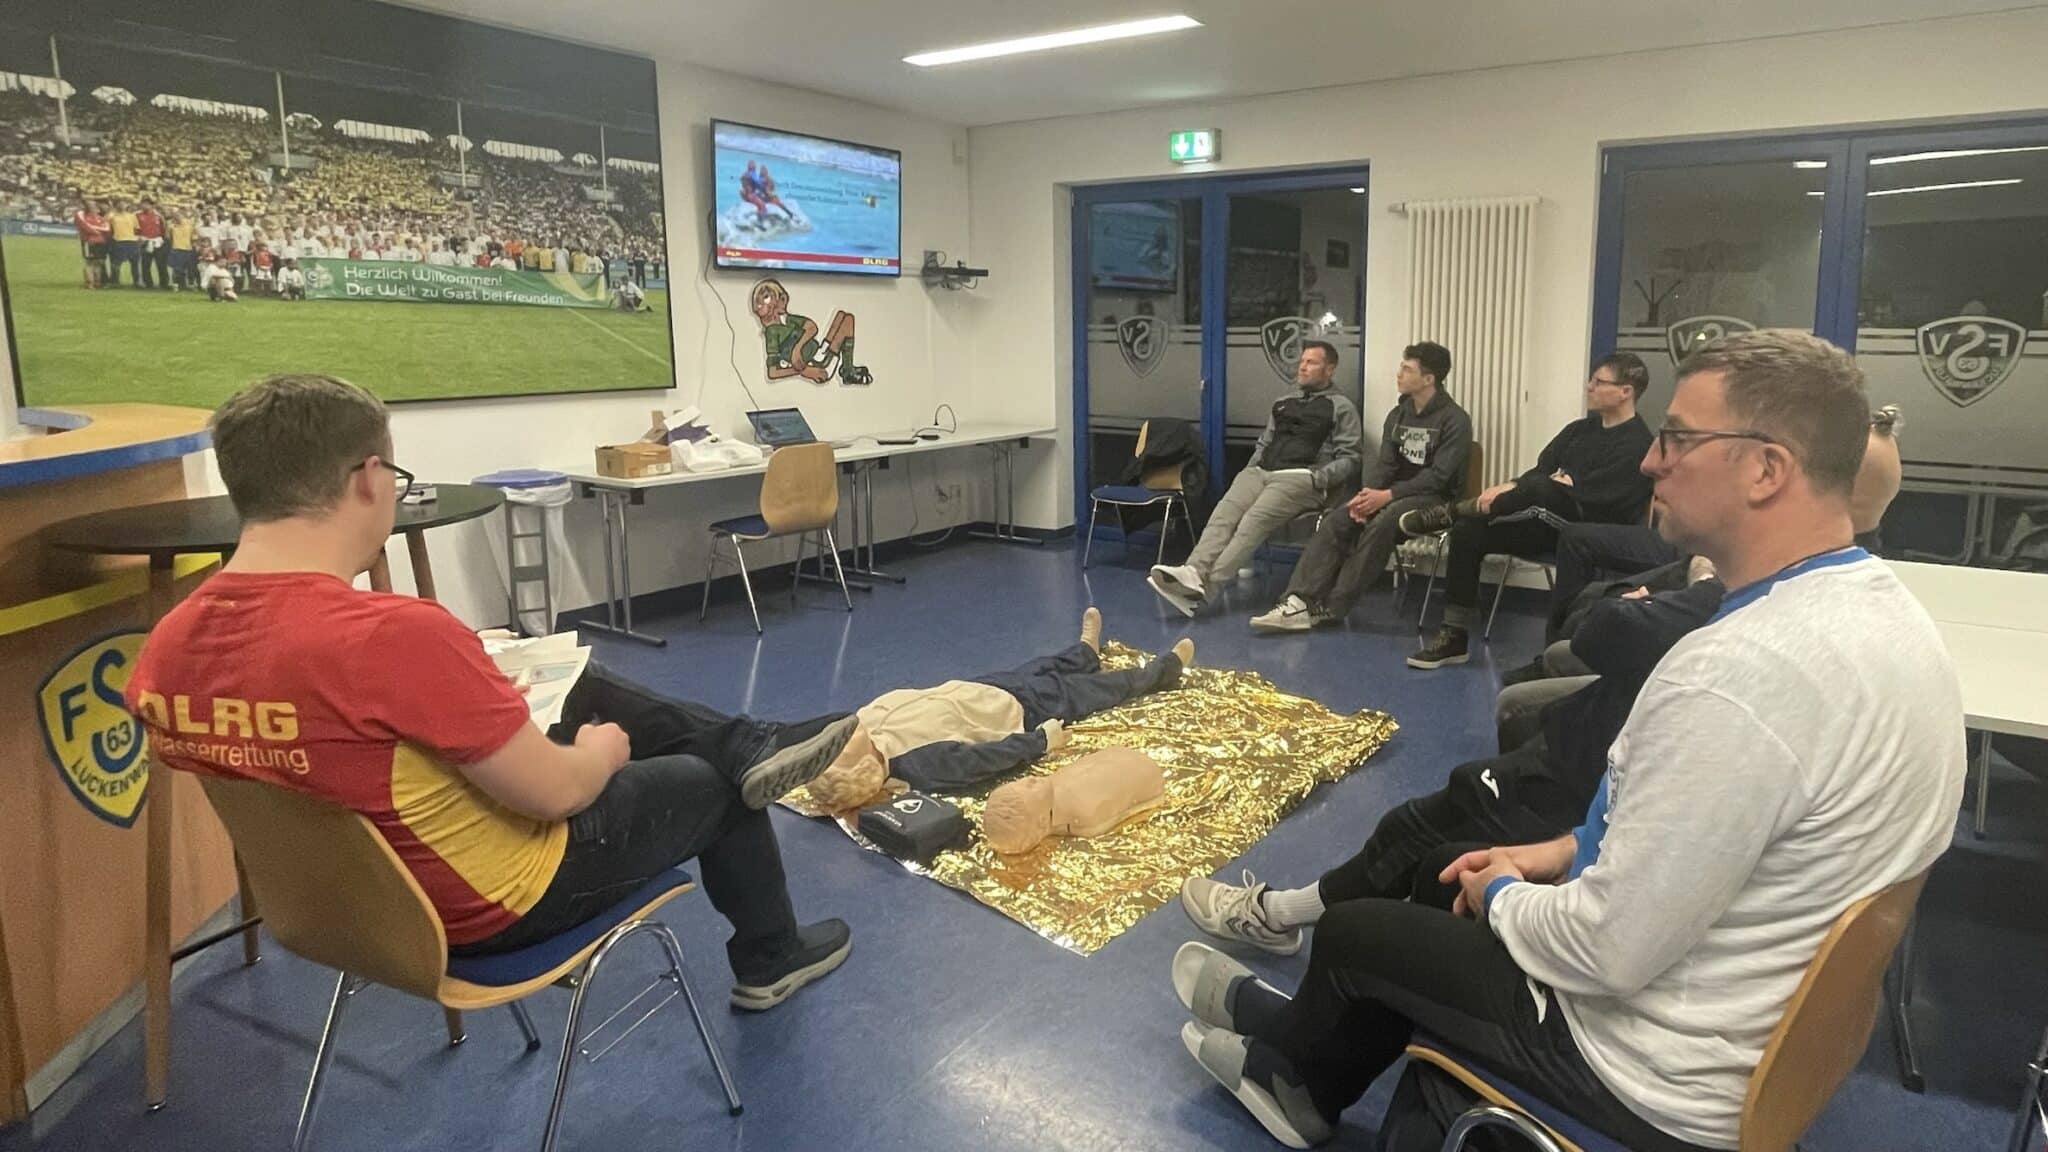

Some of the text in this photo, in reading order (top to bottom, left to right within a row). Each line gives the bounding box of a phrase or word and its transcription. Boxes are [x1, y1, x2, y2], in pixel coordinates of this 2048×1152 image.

[343, 265, 503, 287] Herzlich Willkommen!
[345, 282, 564, 305] Die Welt zu Gast bei Freunden
[138, 690, 299, 742] DLRG
[106, 720, 132, 752] 63
